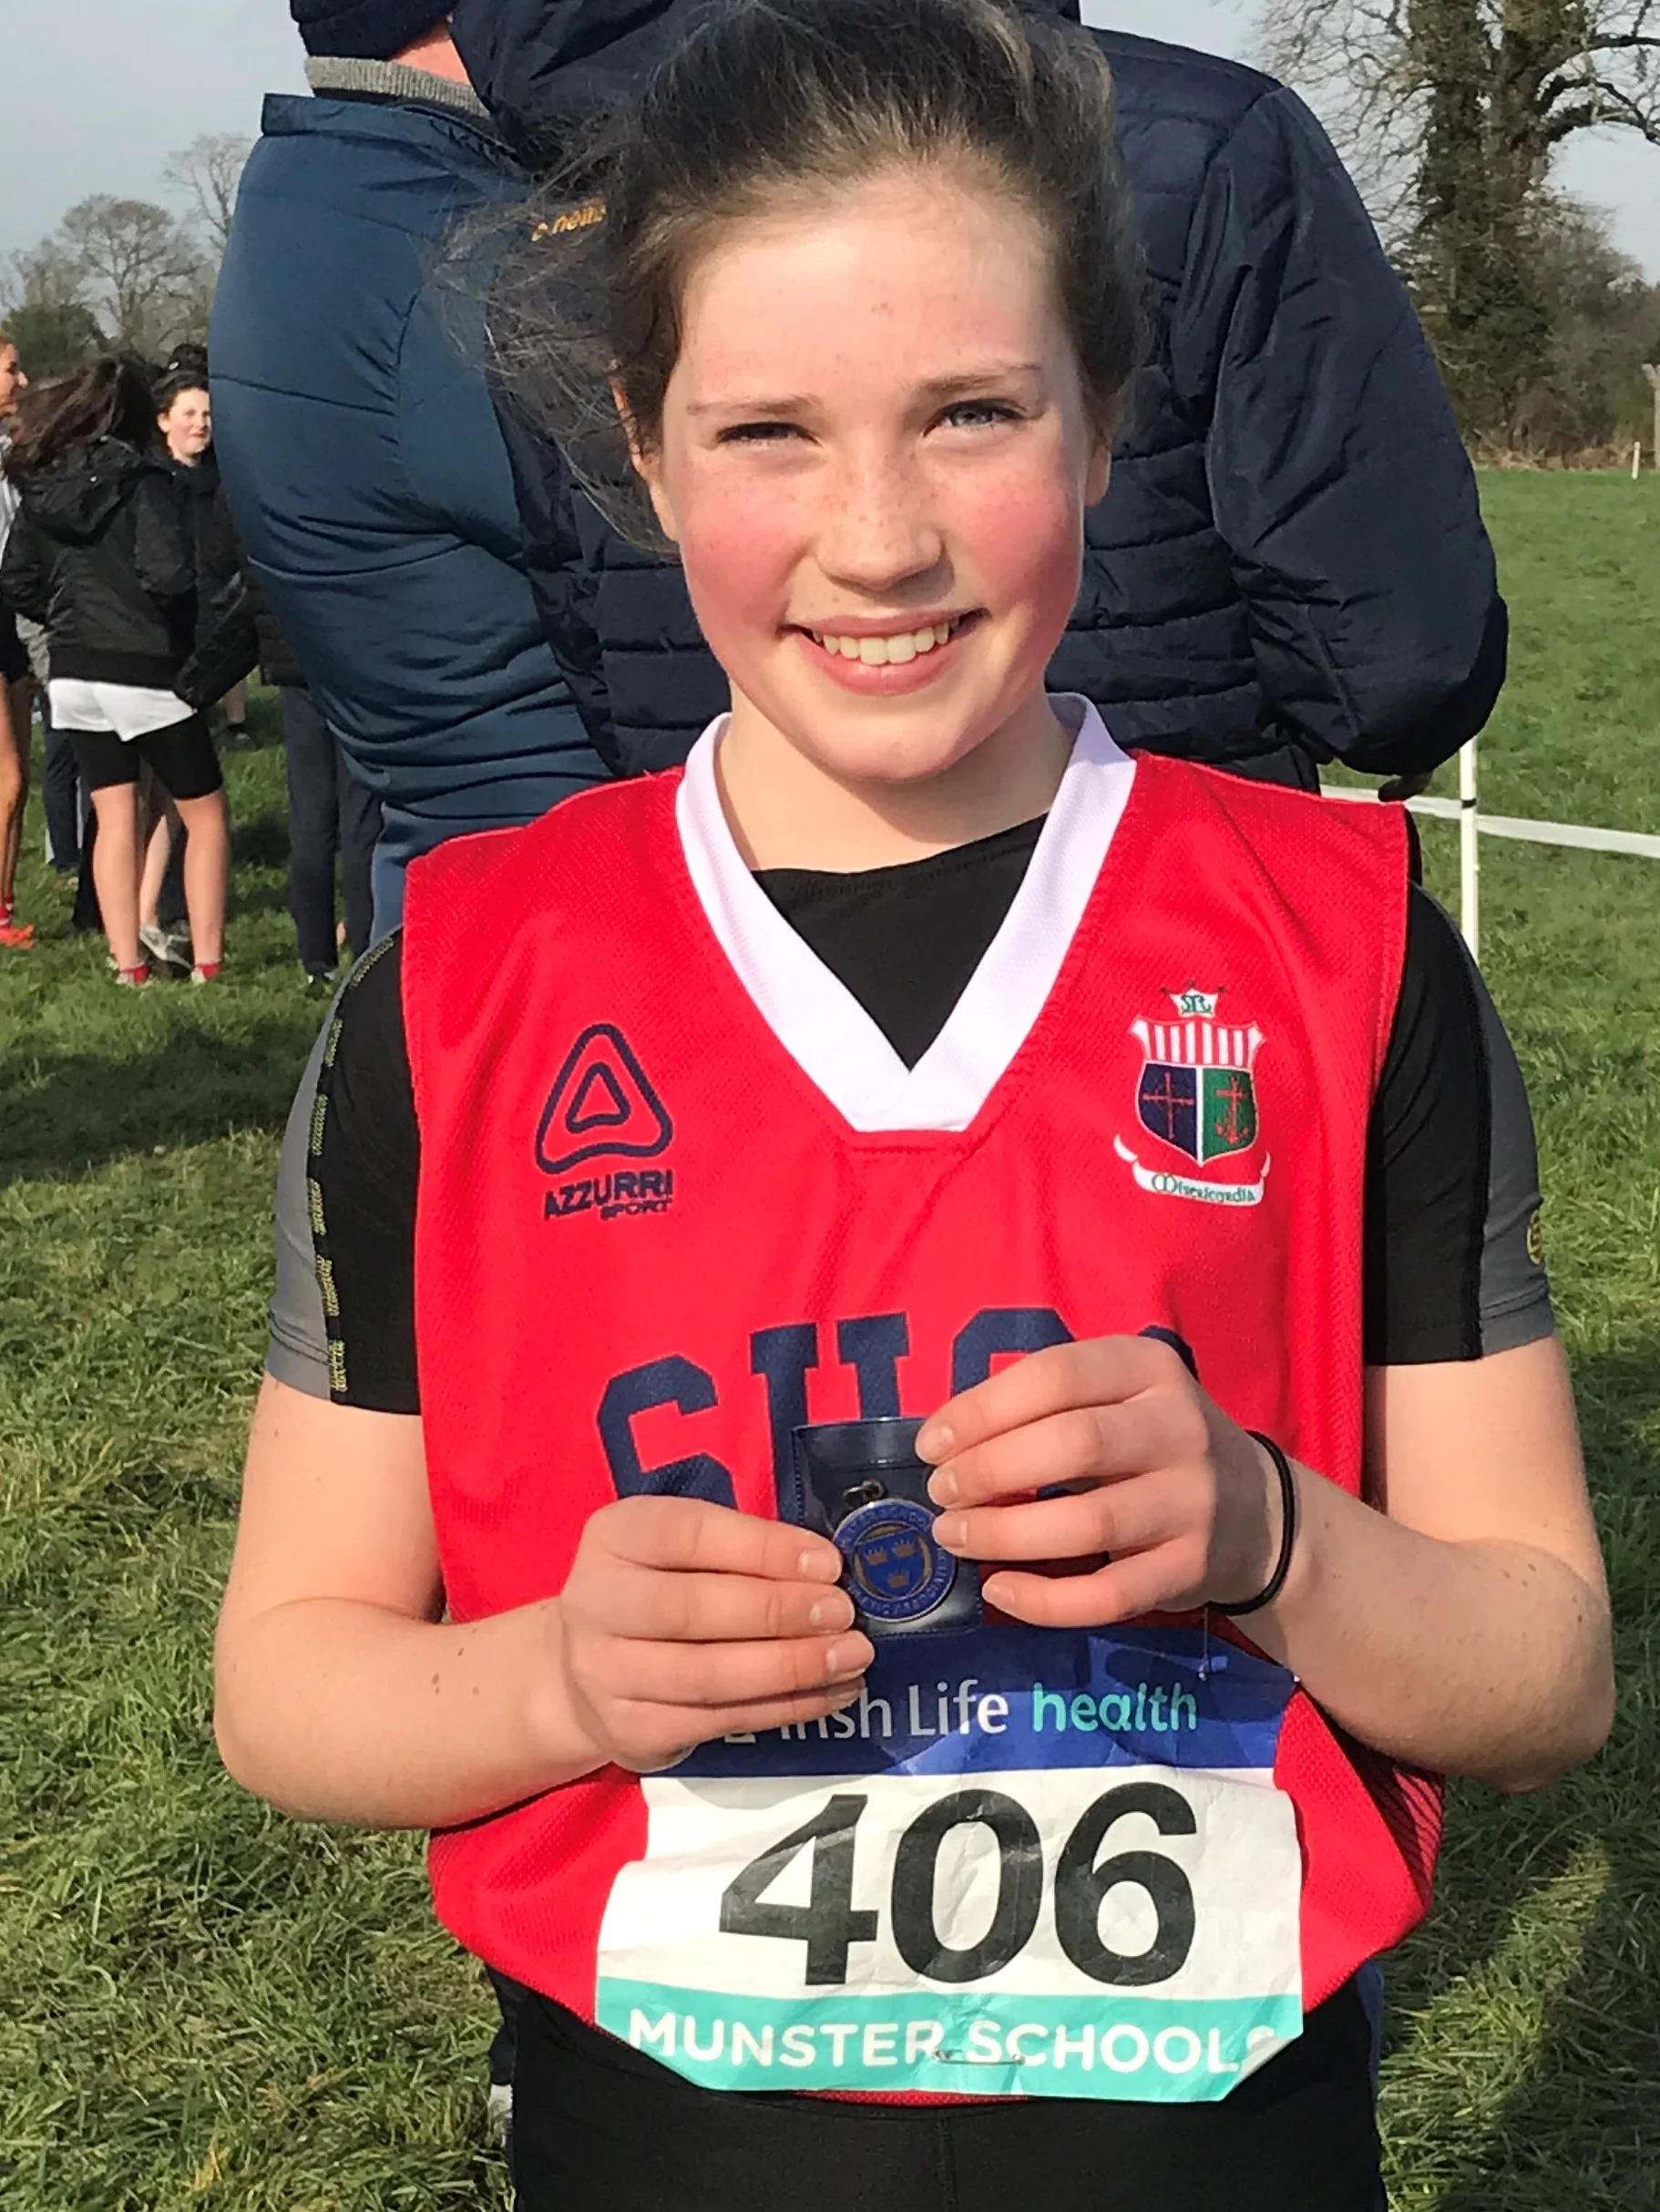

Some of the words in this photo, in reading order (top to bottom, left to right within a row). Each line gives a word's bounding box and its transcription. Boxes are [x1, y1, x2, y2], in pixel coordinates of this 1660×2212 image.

[544, 1169, 673, 1221] AZZURRI
[600, 1198, 672, 1221] SPORT
[908, 1680, 1009, 1735] Life
[1033, 1682, 1197, 1732] health
[719, 1782, 1197, 1987] 406
[629, 2009, 945, 2067] MUNSTER
